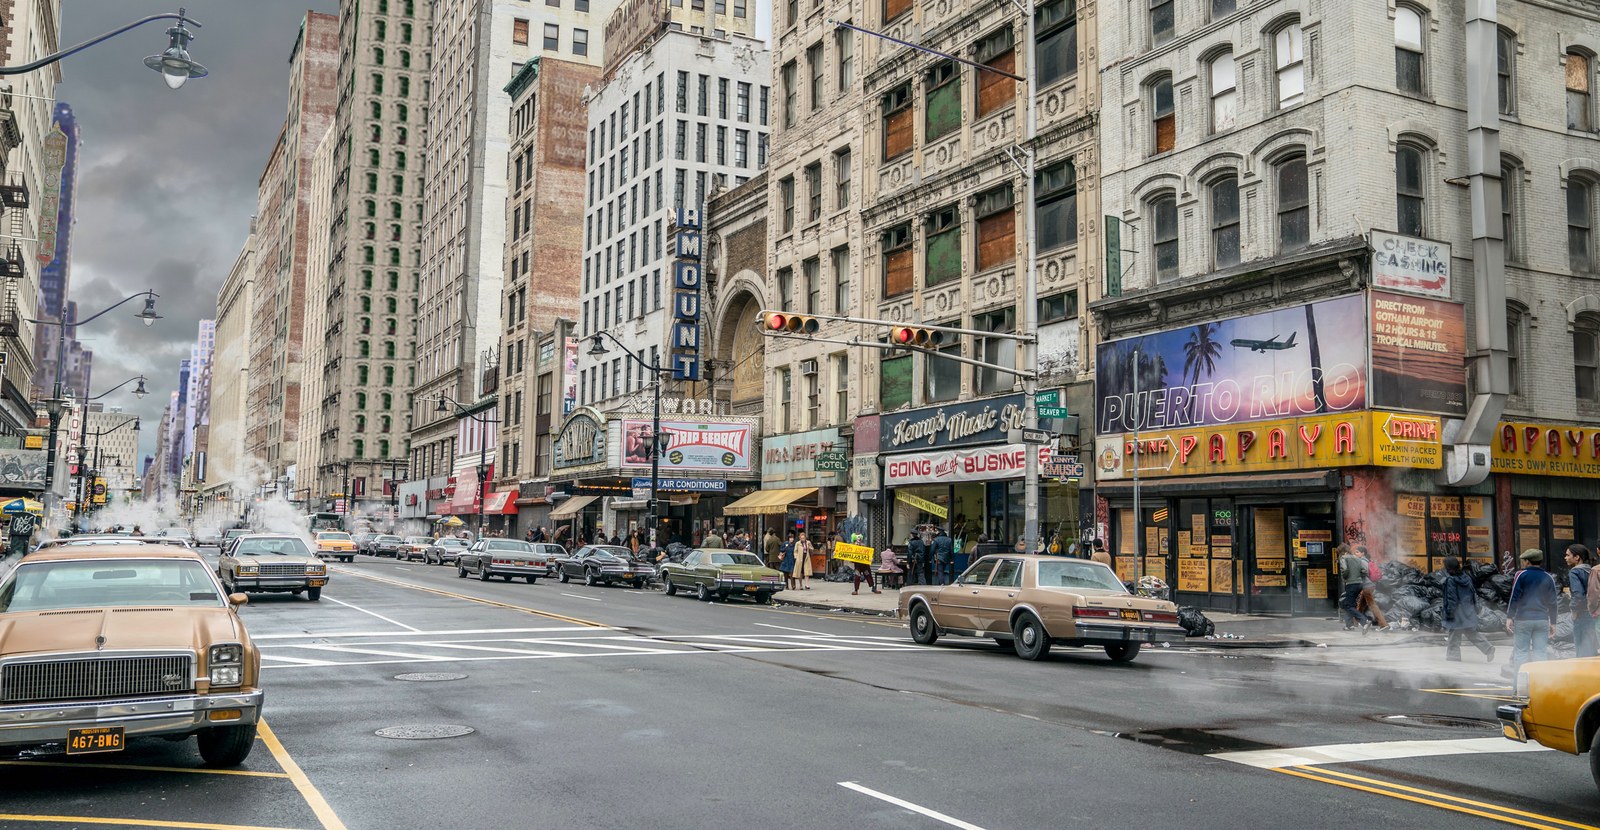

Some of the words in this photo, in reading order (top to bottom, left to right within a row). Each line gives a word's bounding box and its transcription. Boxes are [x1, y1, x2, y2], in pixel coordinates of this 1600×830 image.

[1383, 238, 1438, 259] CHECK
[1375, 252, 1447, 276] CASHING
[679, 209, 699, 378] AMOUNT
[1375, 299, 1402, 312] DIRECT
[1403, 303, 1425, 315] FROM
[1375, 312, 1410, 324] GOTHAM
[1410, 317, 1444, 329] AIRPORT
[1376, 323, 1385, 332] IN
[1385, 324, 1391, 333] 2
[1392, 325, 1418, 337] HOURS
[1419, 329, 1425, 338] &
[1427, 330, 1436, 339] 15
[1376, 335, 1413, 348] TROPICAL
[1414, 340, 1448, 352] MINUTES.
[1036, 394, 1052, 403] MARKET
[1101, 379, 1241, 433] PUERTO
[1250, 362, 1361, 418] RICO
[1039, 408, 1060, 416] BEAVER
[892, 408, 946, 446] Kenny's
[946, 405, 998, 441] Music
[1391, 419, 1438, 439] DRINK
[702, 431, 743, 455] SEARCH
[1125, 440, 1169, 455] DRINK
[1180, 421, 1355, 464] PAPAYA
[1380, 444, 1409, 454] VITAMIN
[1410, 446, 1437, 455] PACKED
[1501, 425, 1600, 458] APAYA
[790, 441, 833, 461] JEWERY
[817, 461, 846, 469] HOTEL
[889, 459, 931, 477] GOING
[935, 460, 948, 475] out
[950, 454, 959, 474] of
[964, 448, 1050, 473] BUSINES
[1382, 454, 1410, 463] HEALTH
[1411, 456, 1435, 465] GIVING
[1491, 458, 1523, 470] ATURE'S
[1527, 460, 1546, 470] OWN
[1049, 464, 1083, 476] MUSIC
[662, 480, 675, 488] AIR
[676, 481, 724, 489] CONDITIONED
[1407, 502, 1442, 511] CHESE
[1445, 503, 1472, 511] FRIS
[1448, 532, 1460, 542] BAR
[72, 734, 120, 748] 467-BWG
